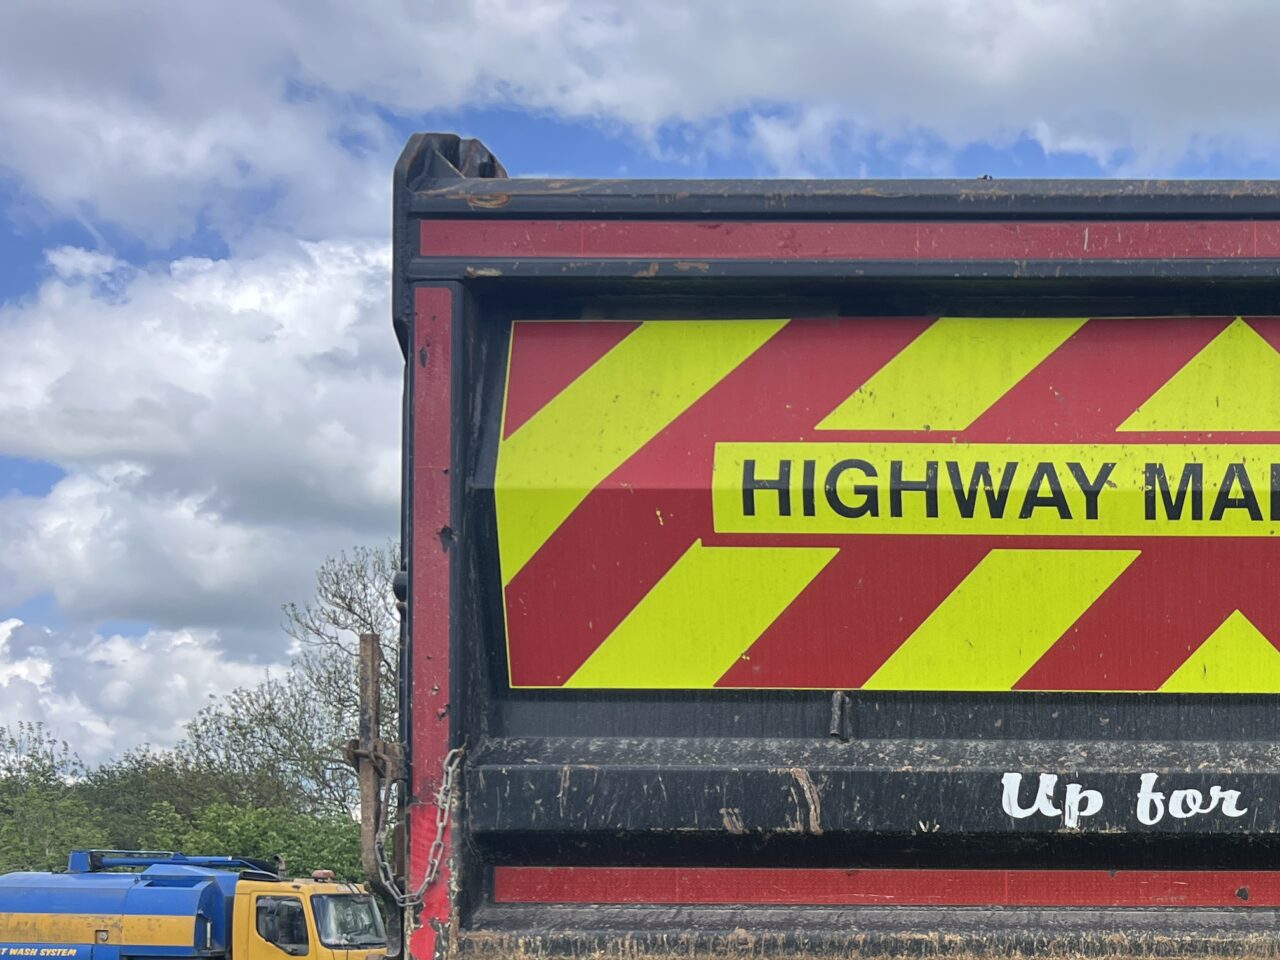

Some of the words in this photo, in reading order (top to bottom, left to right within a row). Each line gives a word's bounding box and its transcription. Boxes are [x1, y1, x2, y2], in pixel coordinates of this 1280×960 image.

[742, 458, 1117, 520] HIGHWAY
[1001, 772, 1103, 828] Up
[1136, 772, 1248, 826] for
[9, 947, 38, 957] WASH
[39, 948, 77, 957] SYSTEM
